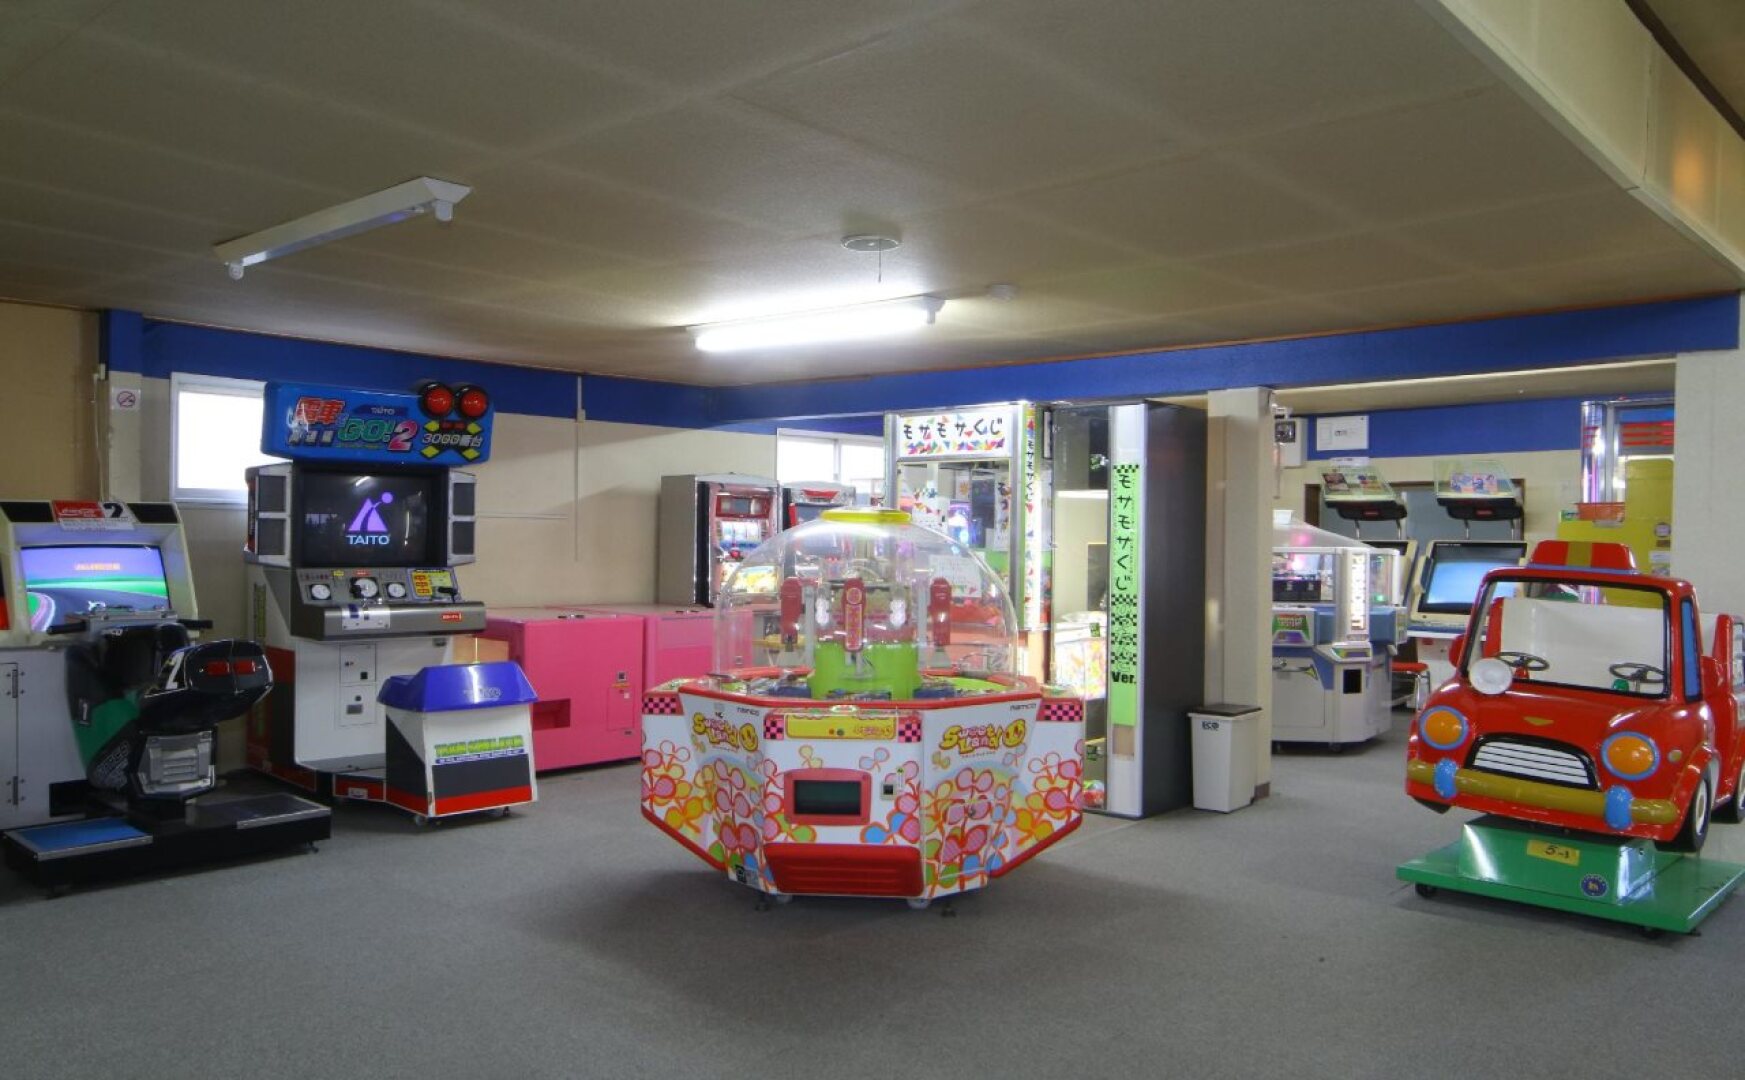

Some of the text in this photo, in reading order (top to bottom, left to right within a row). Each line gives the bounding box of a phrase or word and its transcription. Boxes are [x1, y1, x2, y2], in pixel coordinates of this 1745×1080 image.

[371, 407, 395, 415] TAITO
[388, 420, 418, 450] 2
[903, 418, 1003, 440] モサモサくじ
[346, 535, 390, 545] TAITO
[1116, 474, 1132, 590] モサモサくじ
[1111, 671, 1137, 684] Ver.
[939, 724, 995, 750] Sweet
[959, 725, 1003, 754] Land
[1545, 844, 1570, 859] 5-1
